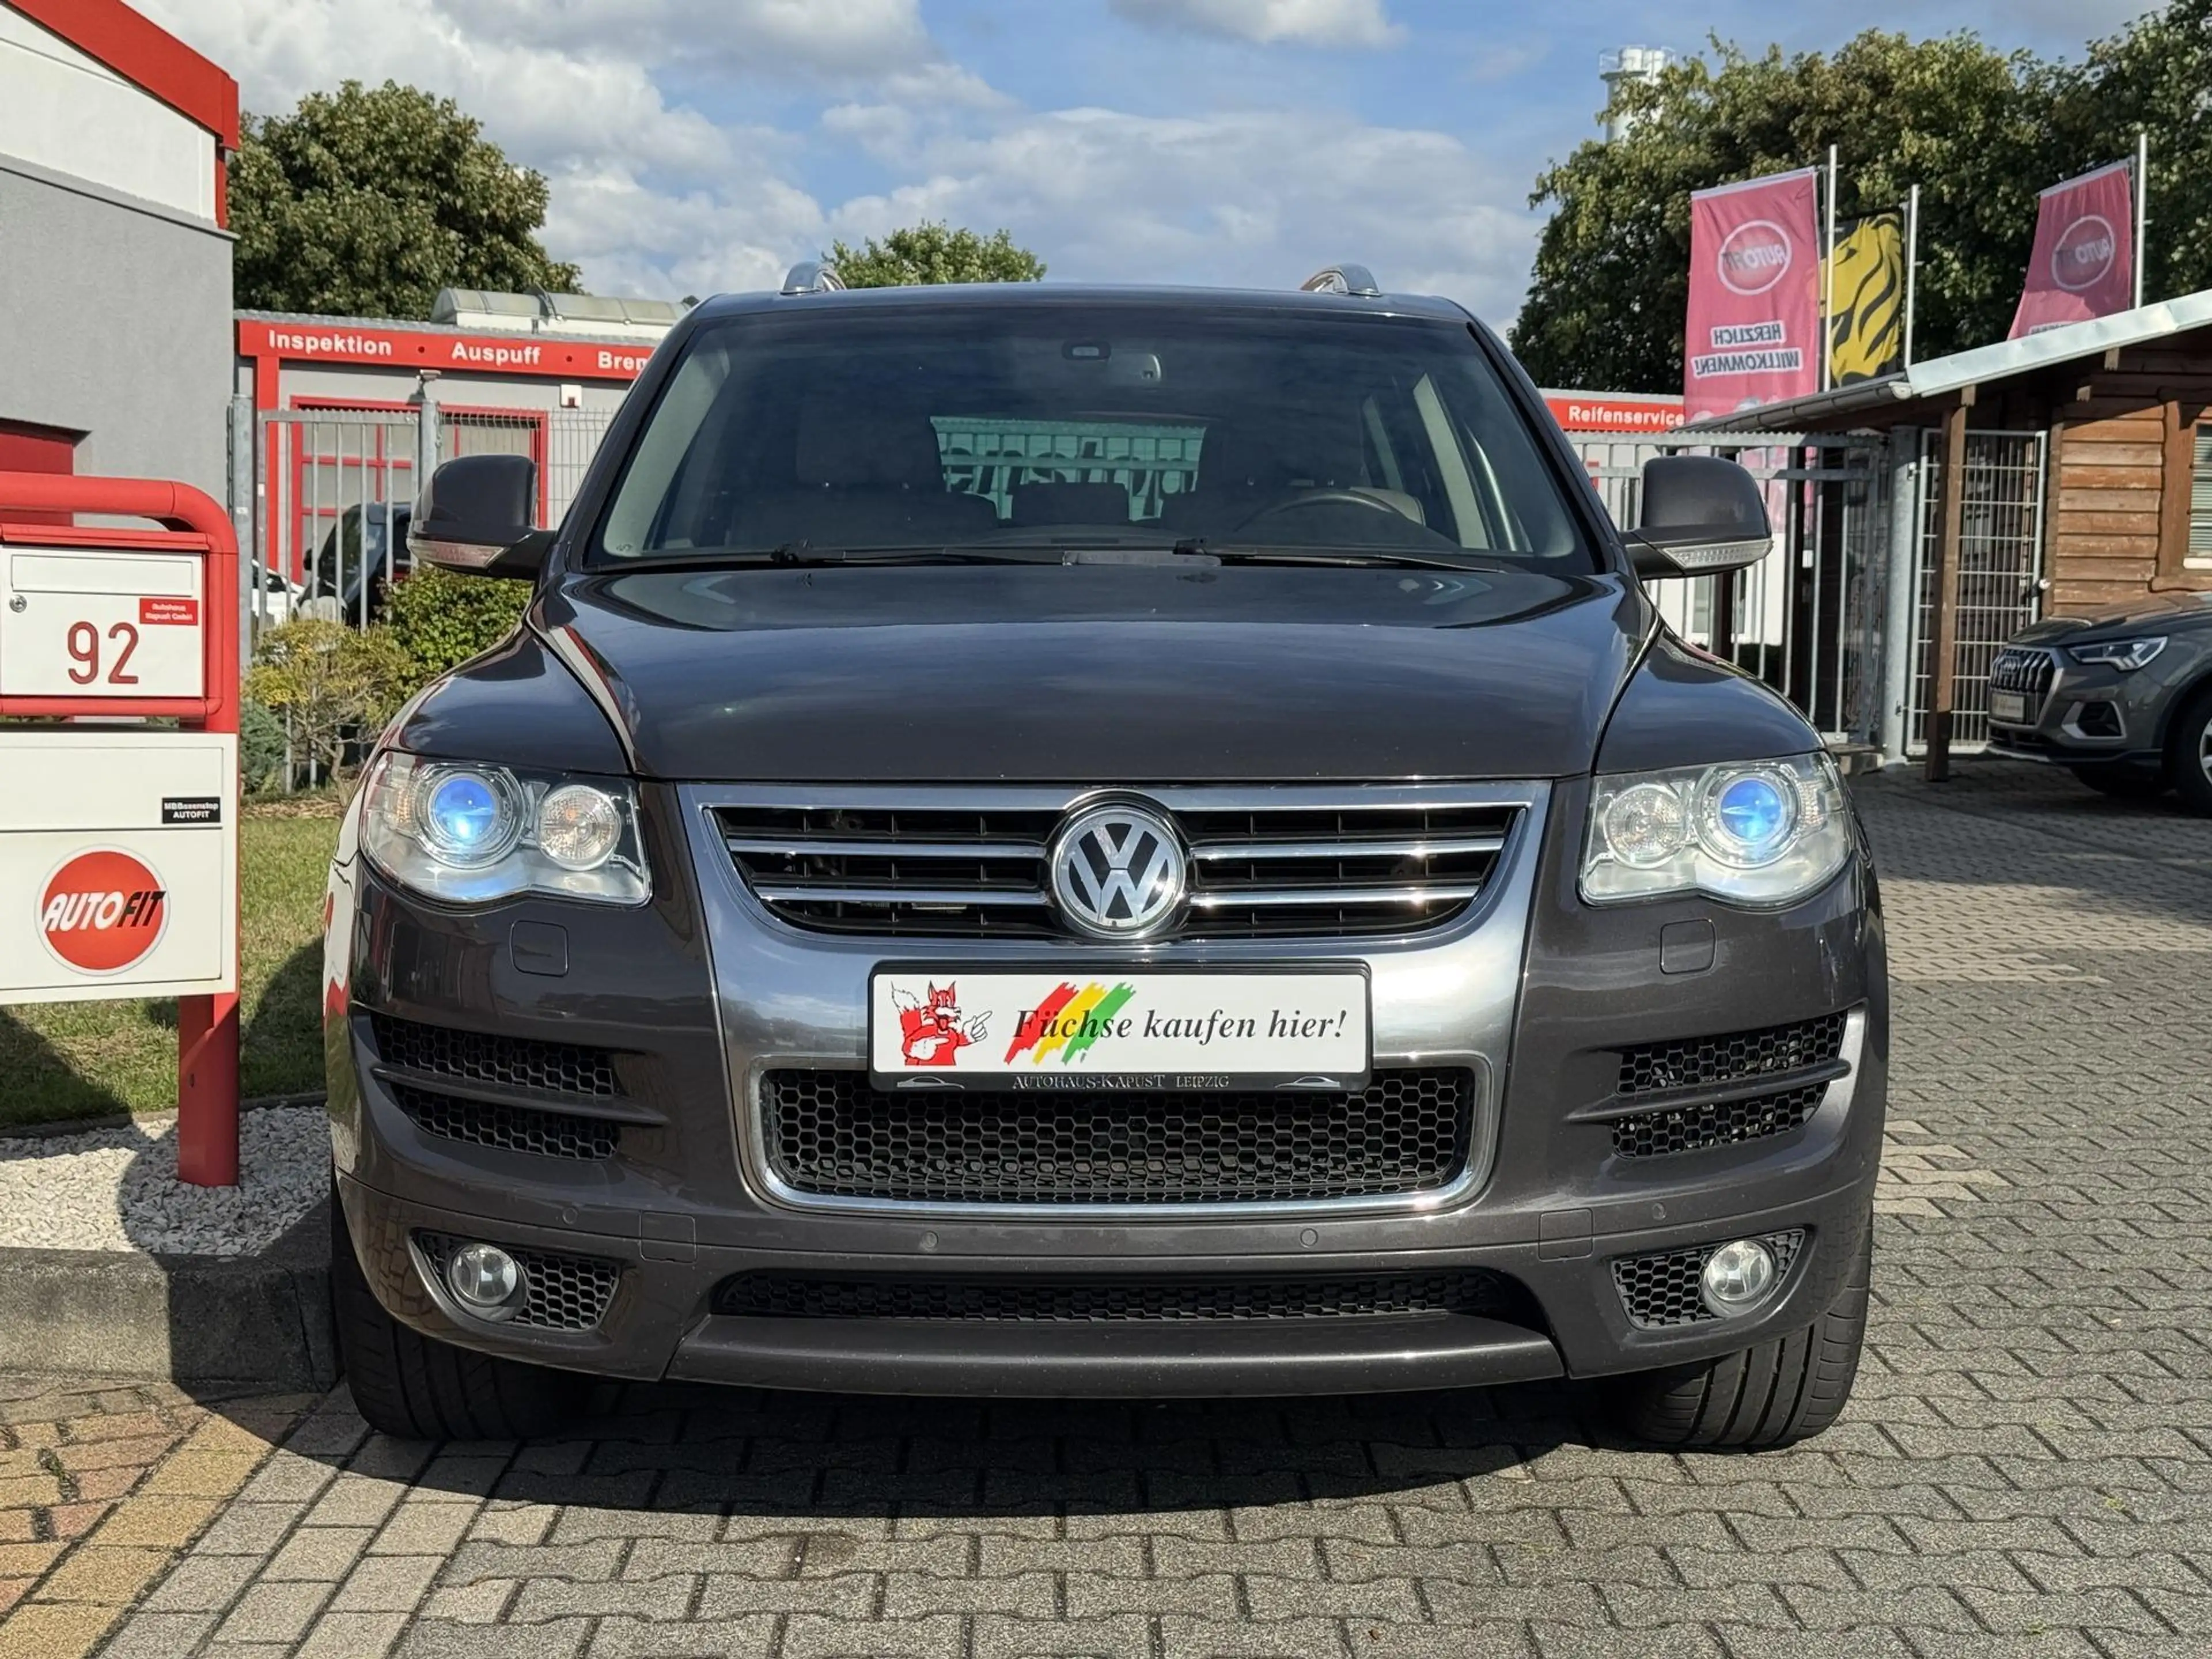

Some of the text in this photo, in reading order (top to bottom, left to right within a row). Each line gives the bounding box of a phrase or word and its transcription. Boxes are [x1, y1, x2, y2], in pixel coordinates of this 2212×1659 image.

[269, 329, 392, 356] Inspektion
[452, 341, 541, 366] Auspuff
[1569, 405, 1685, 426] Reifenservice
[68, 621, 139, 684] 92
[173, 810, 210, 819] AUTOFIT
[42, 891, 166, 932] AUTOFIT
[1013, 1009, 1347, 1046] Füchse kaufen hier!
[1176, 1075, 1230, 1088] LEIPZIG
